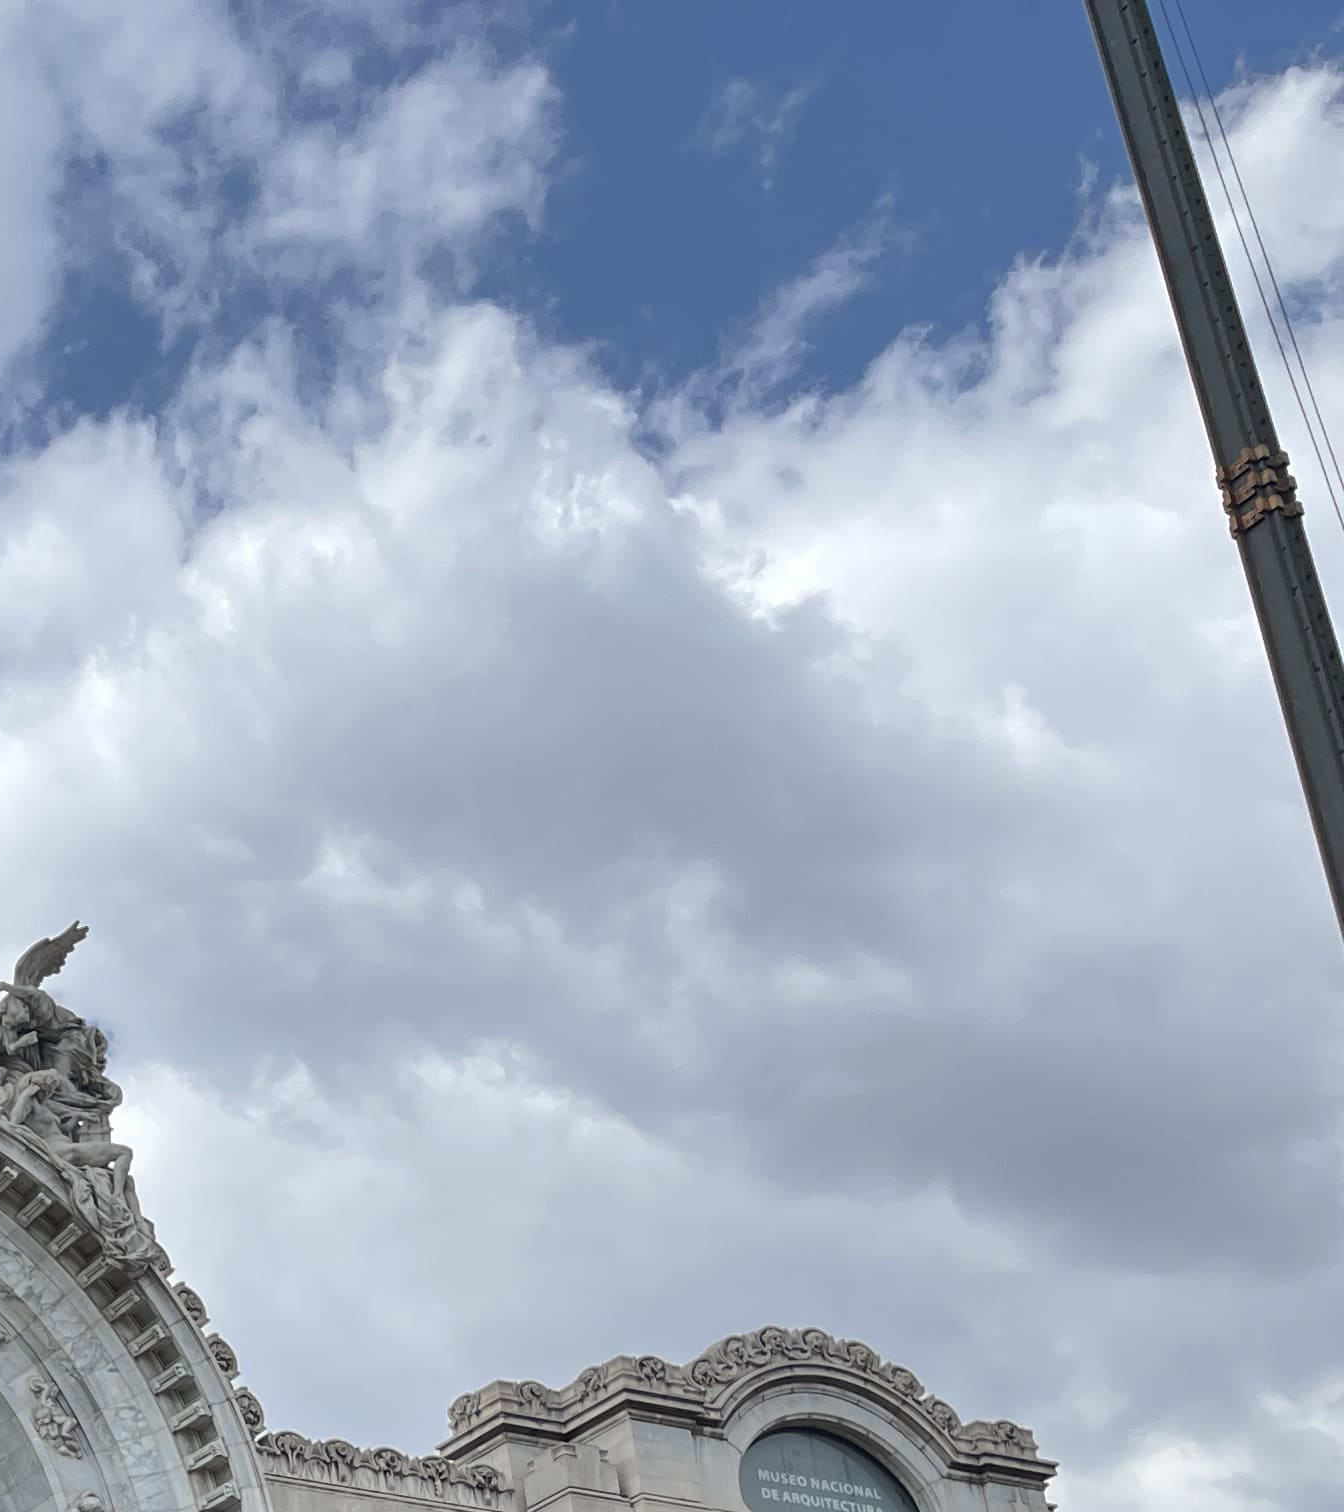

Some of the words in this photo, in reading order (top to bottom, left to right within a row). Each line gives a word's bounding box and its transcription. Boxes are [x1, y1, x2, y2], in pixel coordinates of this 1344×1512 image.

[757, 1468, 807, 1488] MUSEO
[809, 1477, 882, 1500] NACIONAL
[761, 1487, 780, 1501] DE
